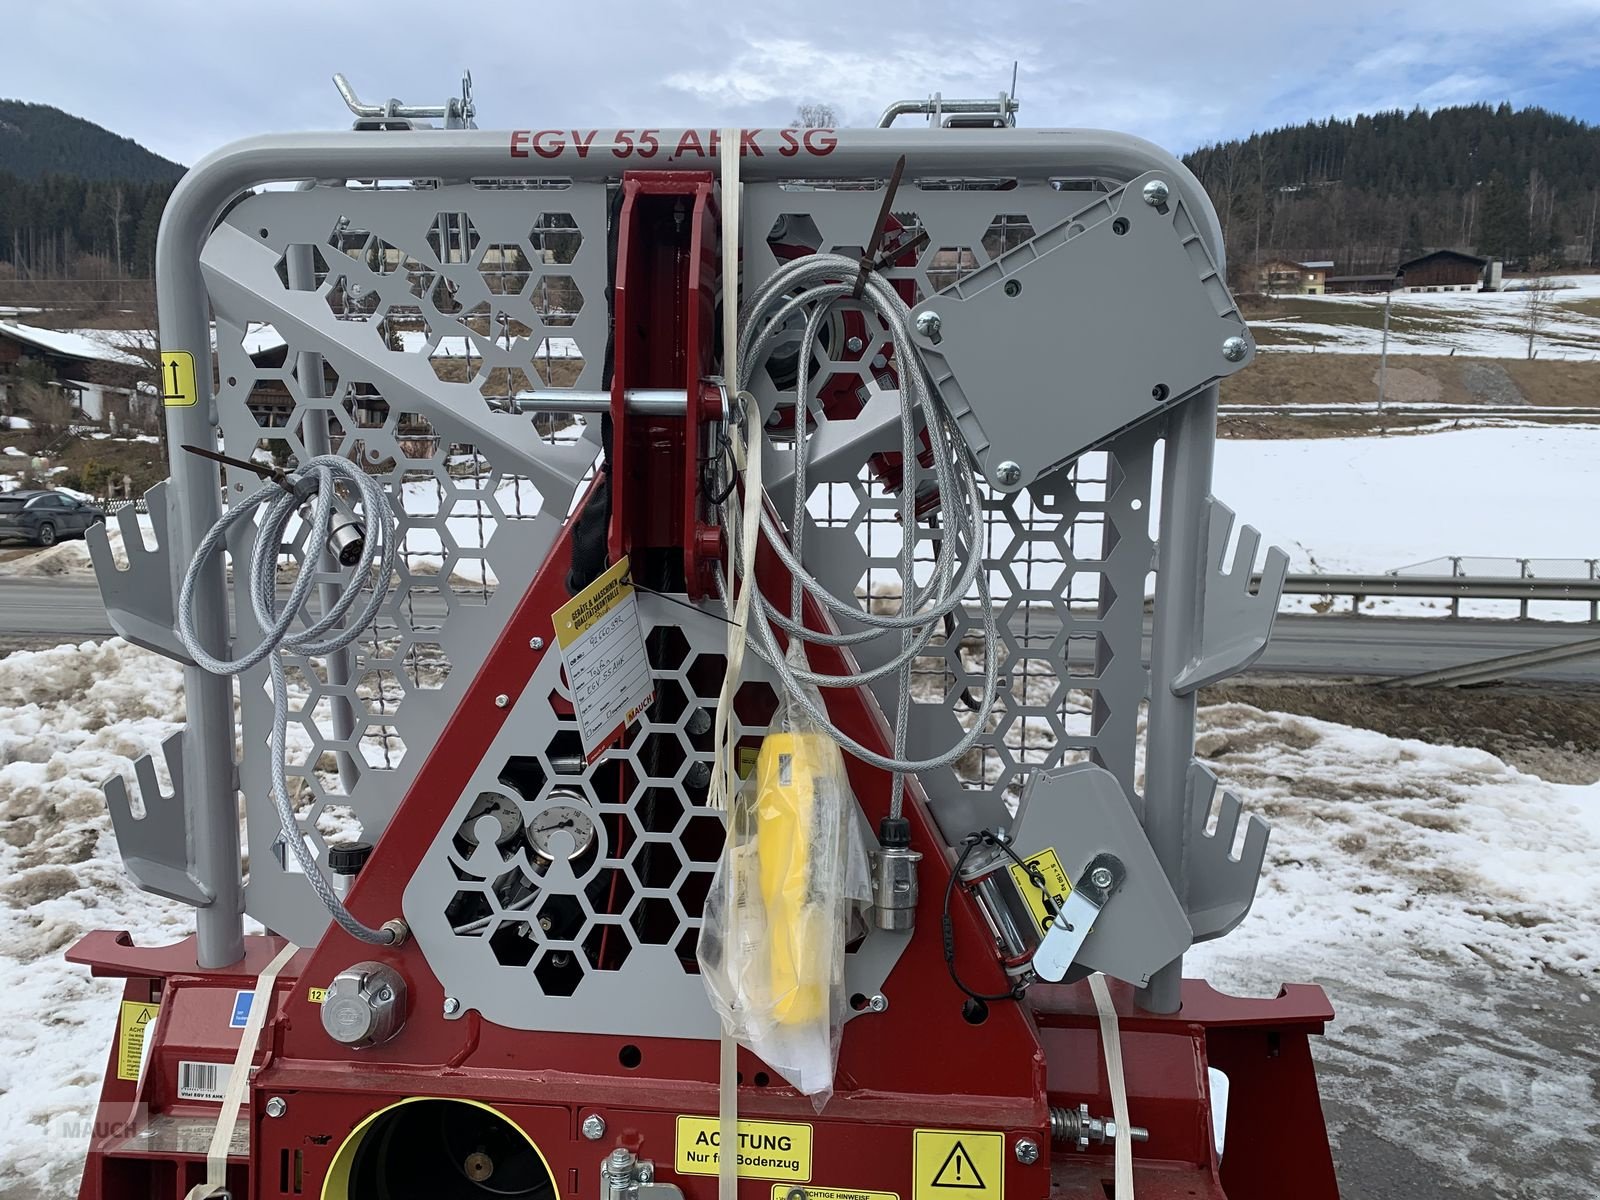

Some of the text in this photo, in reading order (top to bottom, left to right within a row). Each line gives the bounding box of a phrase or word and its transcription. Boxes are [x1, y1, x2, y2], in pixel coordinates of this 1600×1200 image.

[510, 129, 599, 158] EGV
[611, 129, 661, 158] 55
[777, 129, 838, 158] SG
[627, 693, 652, 722] MAUCH
[311, 990, 322, 1000] 12
[695, 1130, 792, 1151] ACTUNG
[686, 1150, 710, 1163] Nur
[736, 1154, 800, 1172] Bodenzug
[804, 1190, 835, 1199] ICHTIGE
